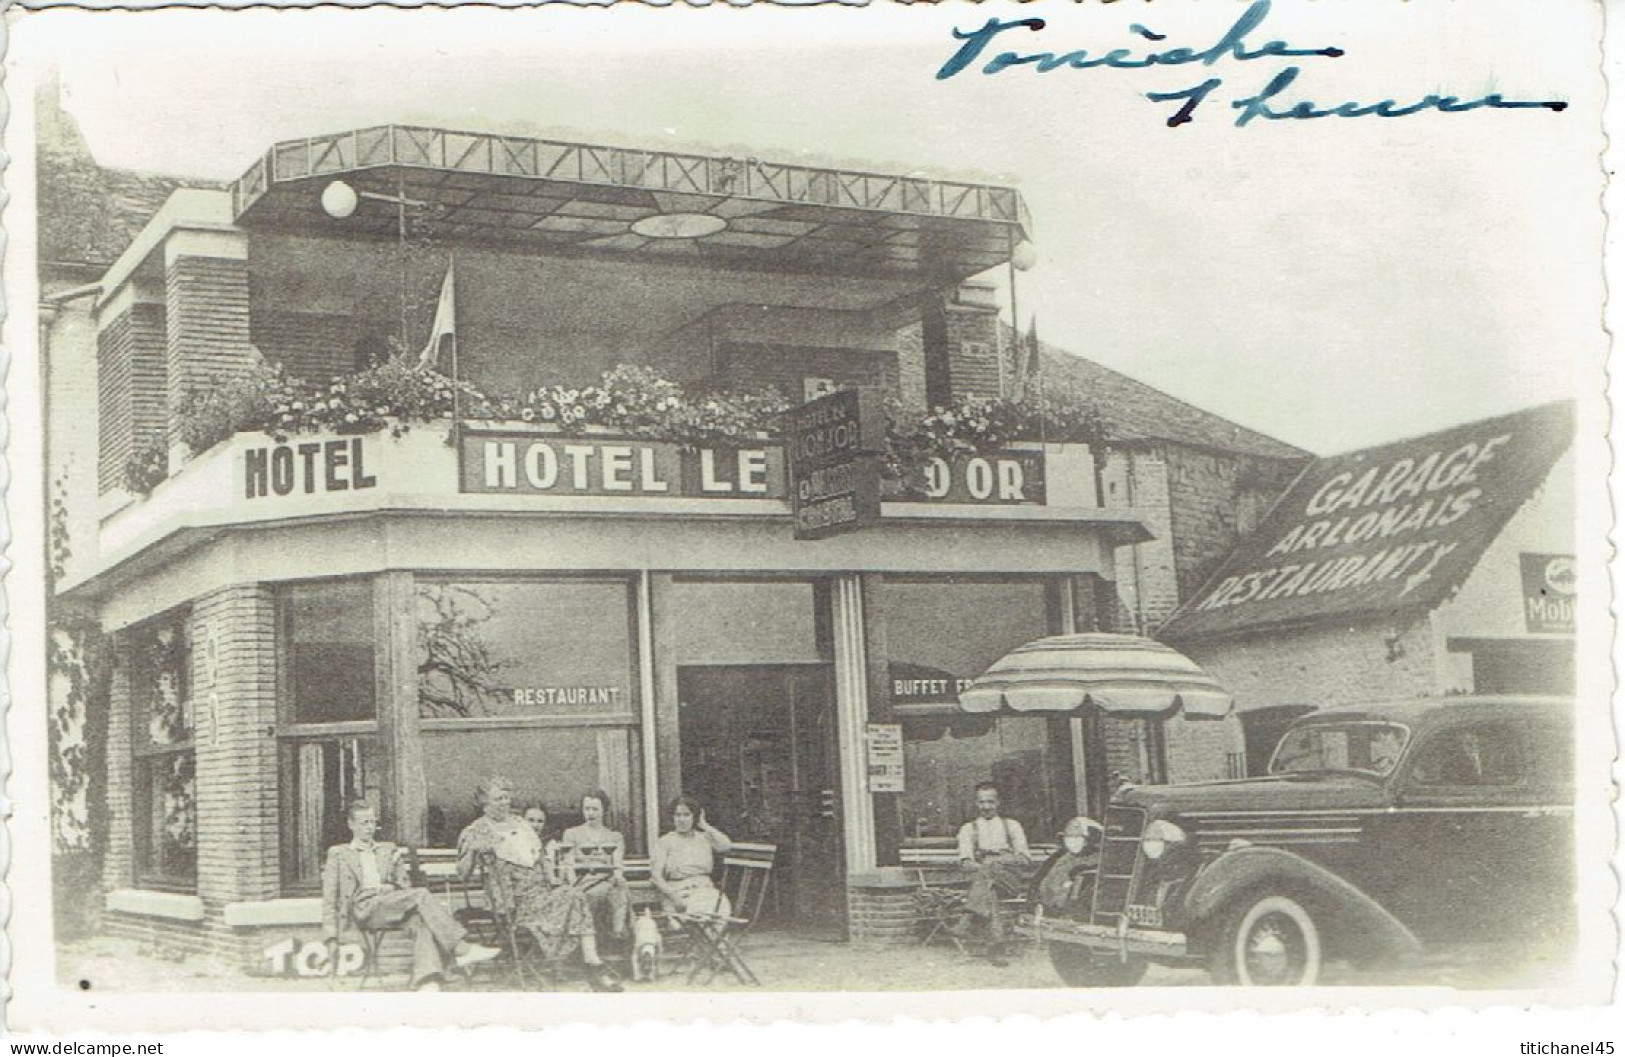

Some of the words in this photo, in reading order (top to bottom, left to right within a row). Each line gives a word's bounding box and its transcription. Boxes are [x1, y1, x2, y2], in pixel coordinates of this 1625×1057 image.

[1232, 67, 1567, 128] heure
[246, 438, 377, 499] HOTEL
[1306, 434, 1512, 517] GARAGE
[1266, 488, 1483, 558] ARLONAIS
[514, 687, 620, 706] RESTAURANT
[894, 679, 948, 696] BUFFET
